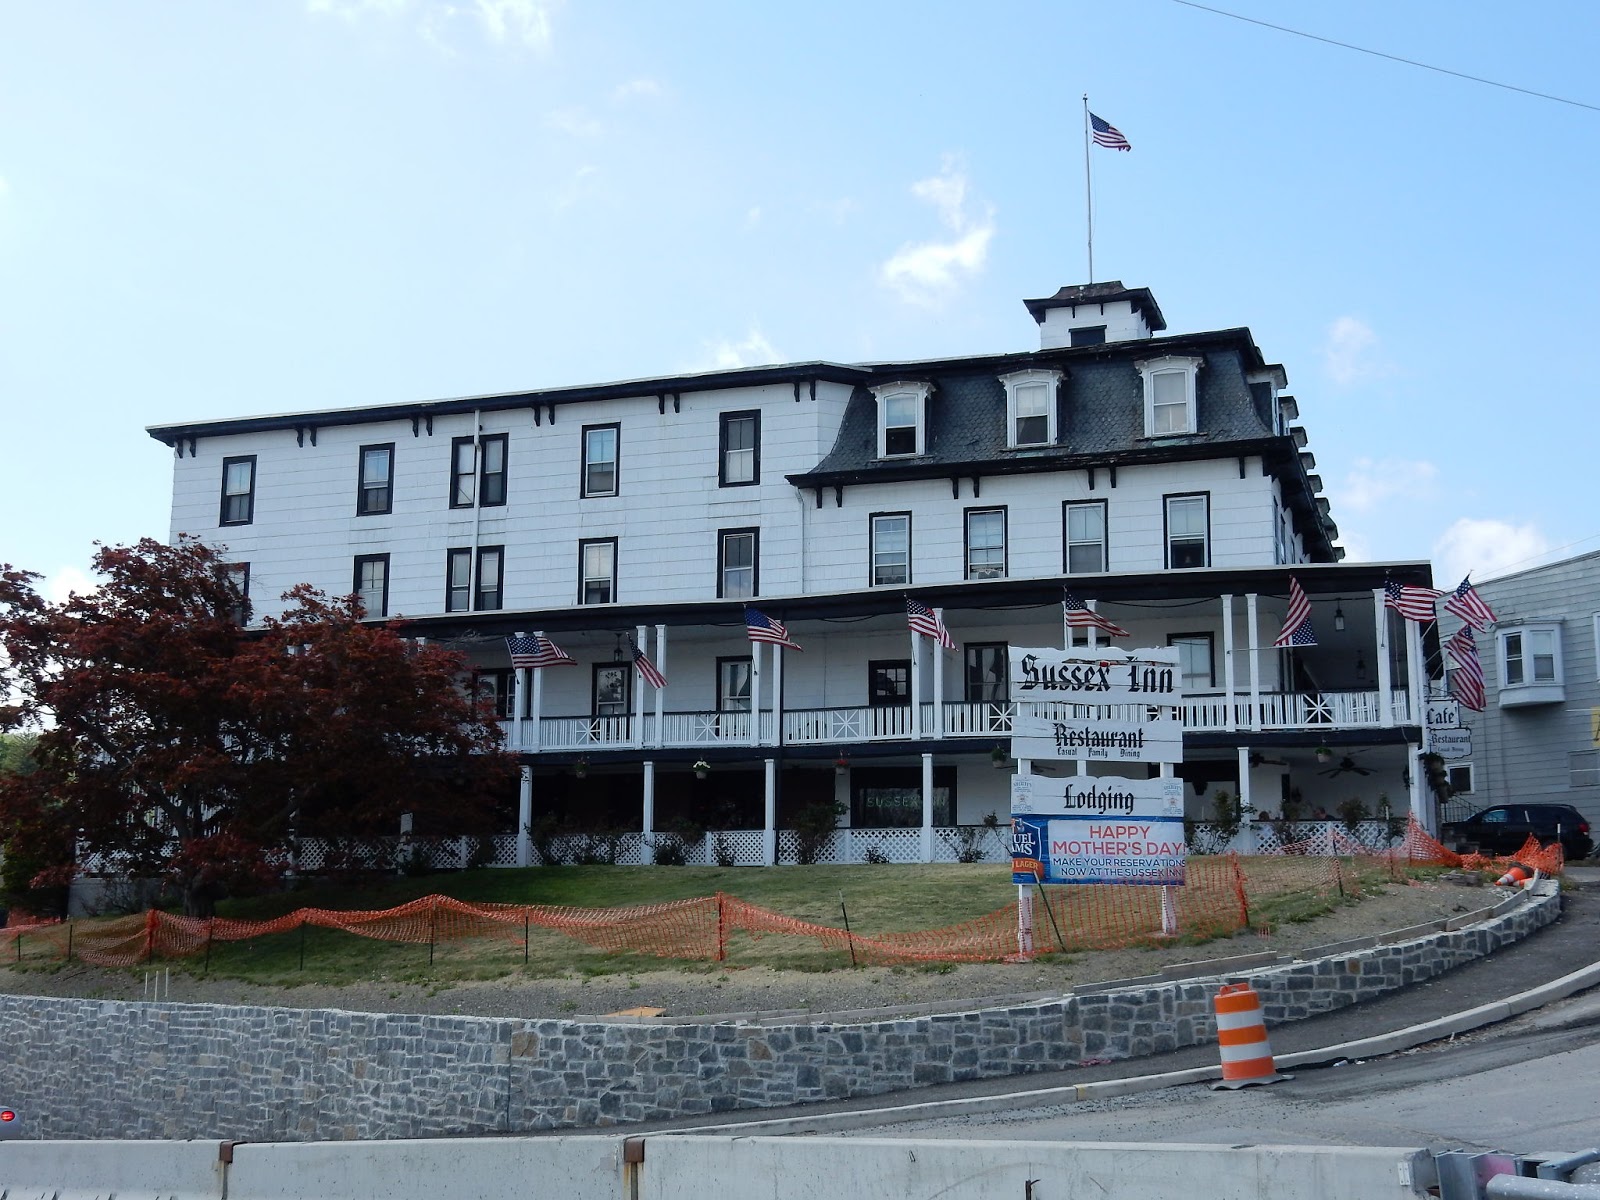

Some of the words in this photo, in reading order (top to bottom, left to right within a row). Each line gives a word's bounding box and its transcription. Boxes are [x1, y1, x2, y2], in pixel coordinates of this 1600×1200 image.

[1020, 653, 1111, 692] Sussex
[1126, 656, 1174, 693] Inn
[1052, 722, 1143, 748] Restaurant
[1431, 733, 1471, 744] Restaurant
[1057, 747, 1078, 756] Casual
[1088, 748, 1108, 758] Family
[1119, 748, 1141, 759] Dining
[866, 796, 920, 808] SUSSEX
[1063, 783, 1135, 815] Lodging
[1090, 825, 1151, 839] HAPPY
[1053, 841, 1142, 856] MOTHER'S
[1146, 842, 1186, 856] DAY!
[1015, 860, 1038, 870] LAGER
[1053, 858, 1082, 866] MAKE
[1084, 858, 1112, 867] YOUR
[1113, 858, 1186, 868] RESERVATIONS
[1061, 867, 1087, 876] NOW
[1088, 867, 1102, 876] AT
[1104, 867, 1124, 877] THE
[1124, 868, 1165, 877] SUSSEX
